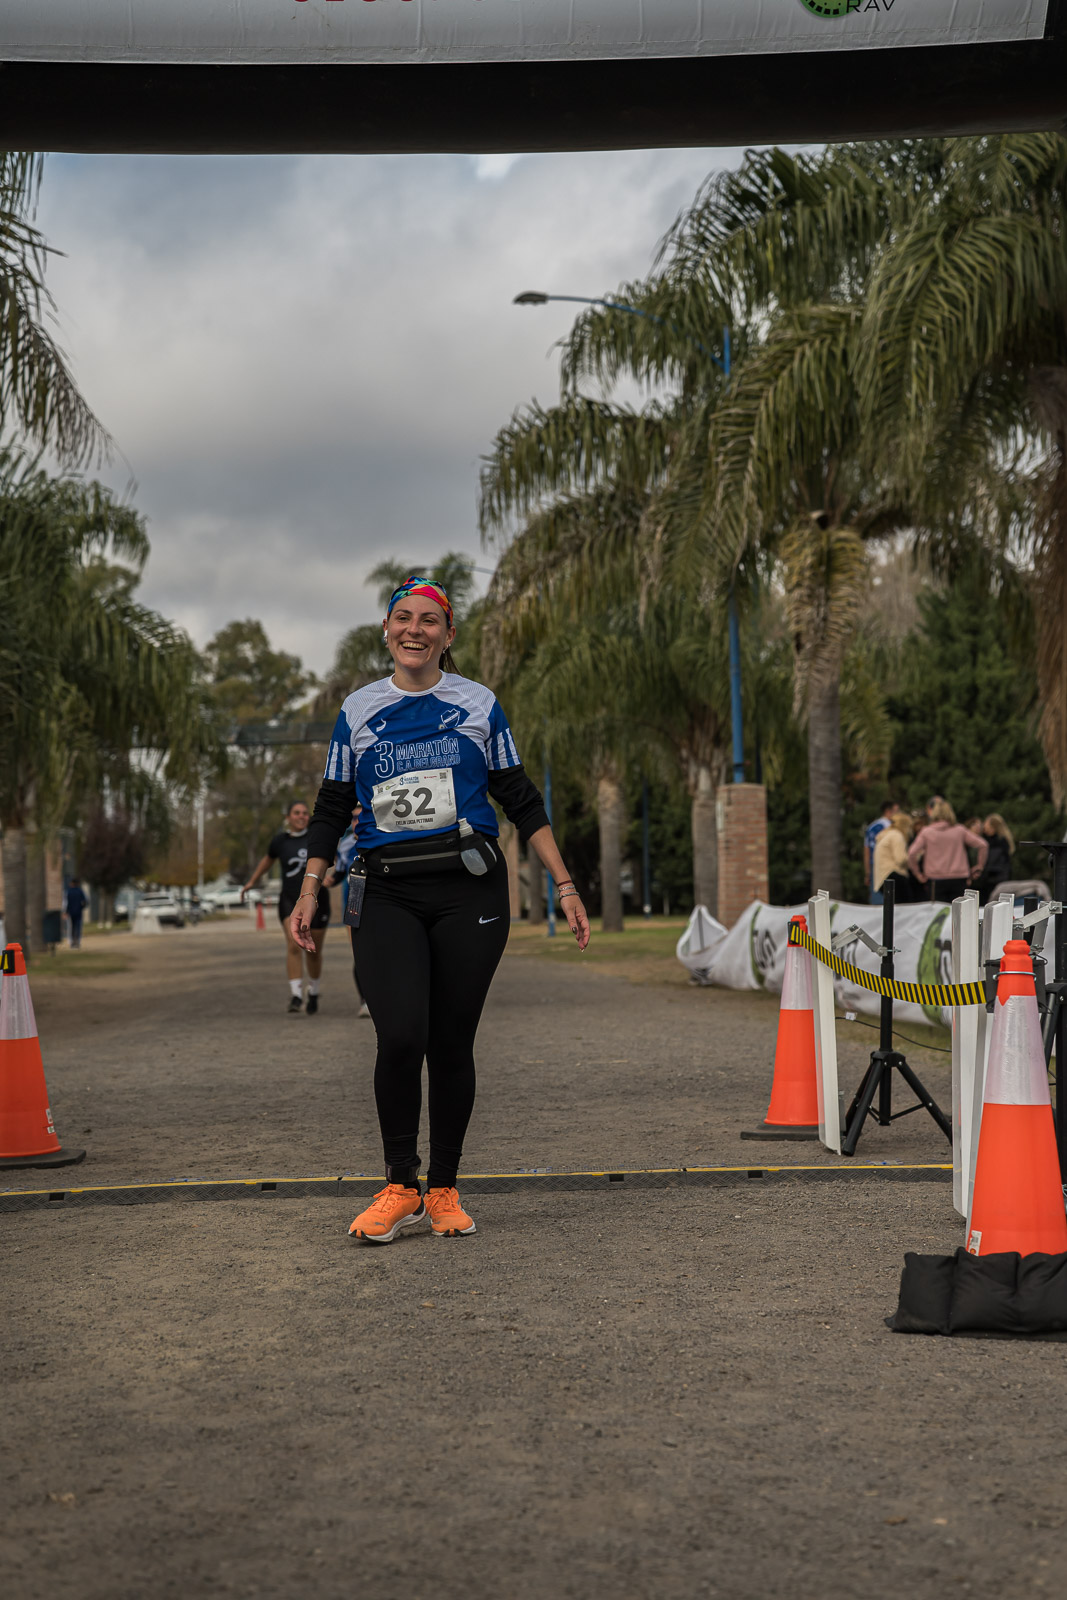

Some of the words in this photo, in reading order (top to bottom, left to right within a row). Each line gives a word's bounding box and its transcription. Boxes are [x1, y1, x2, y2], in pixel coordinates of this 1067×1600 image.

[374, 740, 395, 778] 3
[396, 736, 460, 760] MARATÓN
[391, 787, 435, 818] 32
